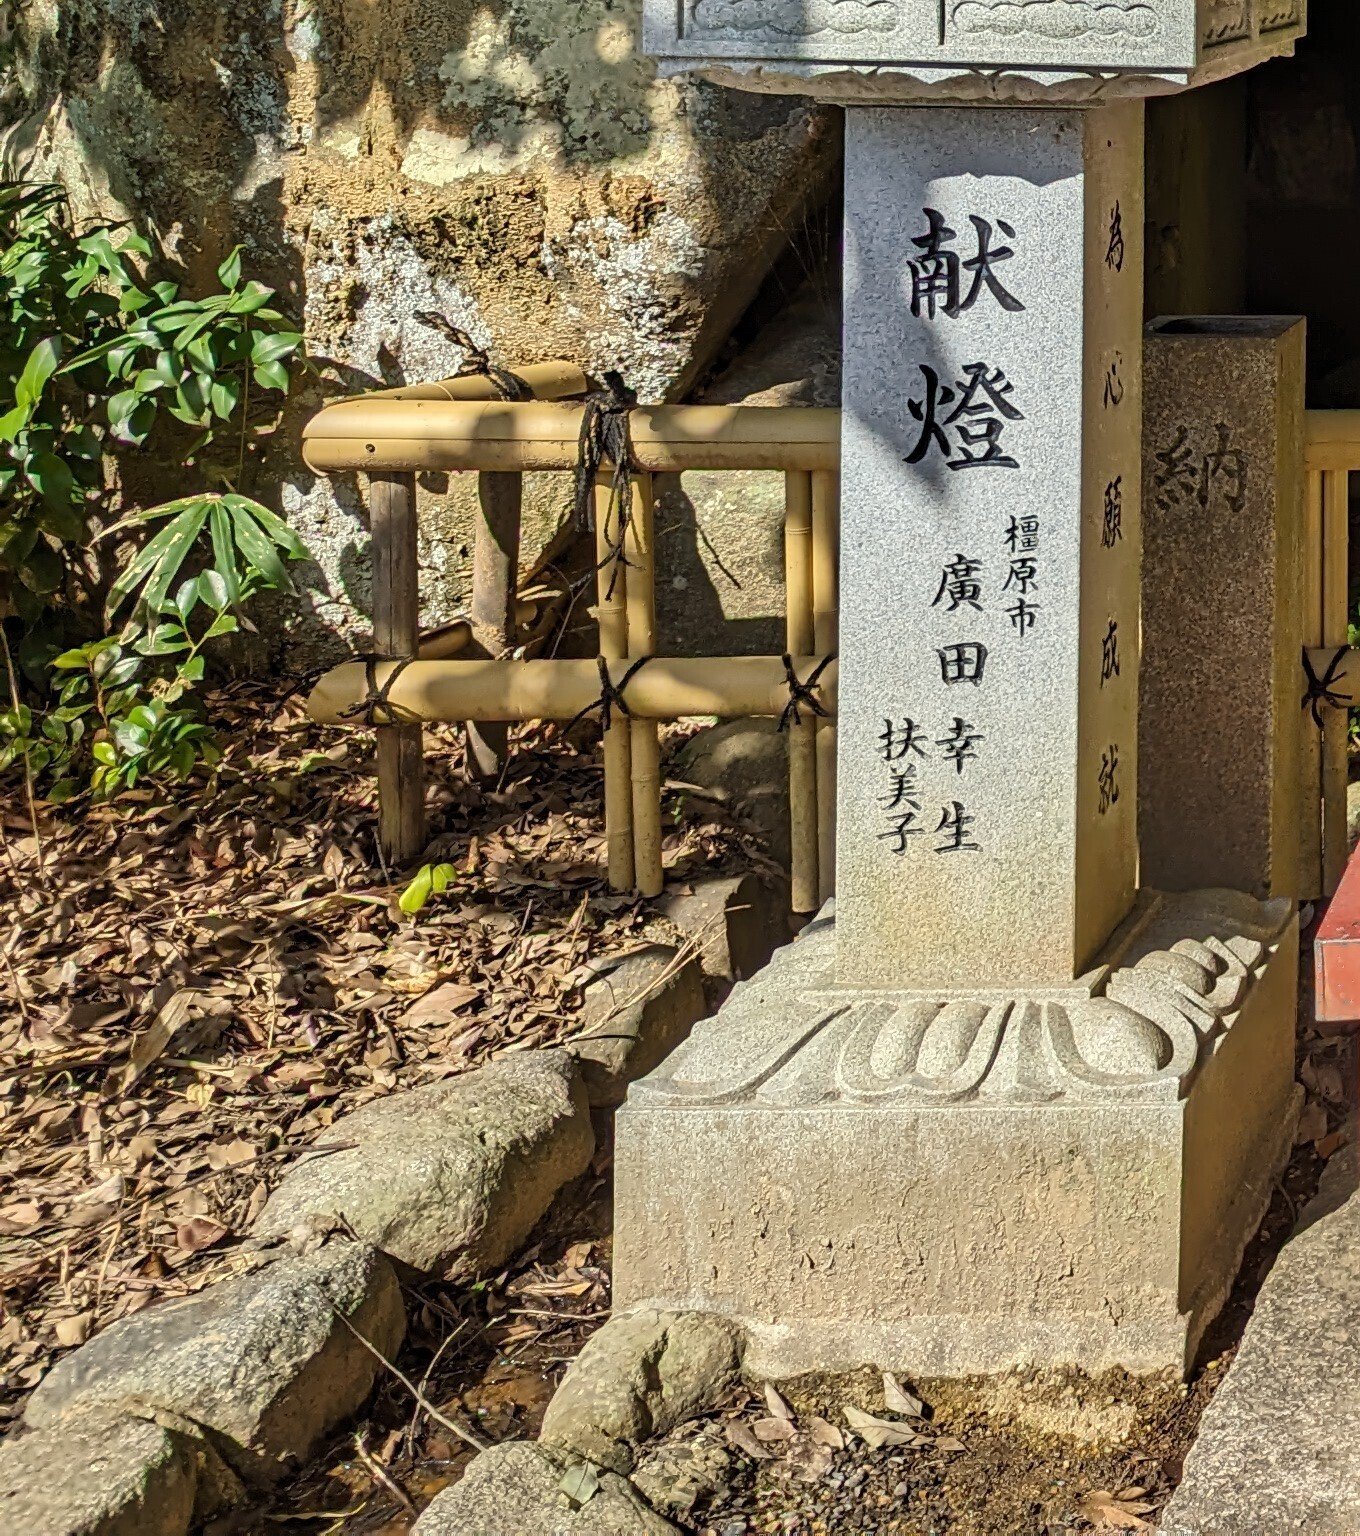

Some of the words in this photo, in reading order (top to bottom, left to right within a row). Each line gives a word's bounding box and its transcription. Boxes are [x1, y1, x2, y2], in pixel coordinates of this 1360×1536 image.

[900, 206, 1026, 473] 献燈
[1154, 421, 1249, 514] 納
[1002, 514, 1041, 638] 橿原市
[876, 716, 932, 855] 扶美子
